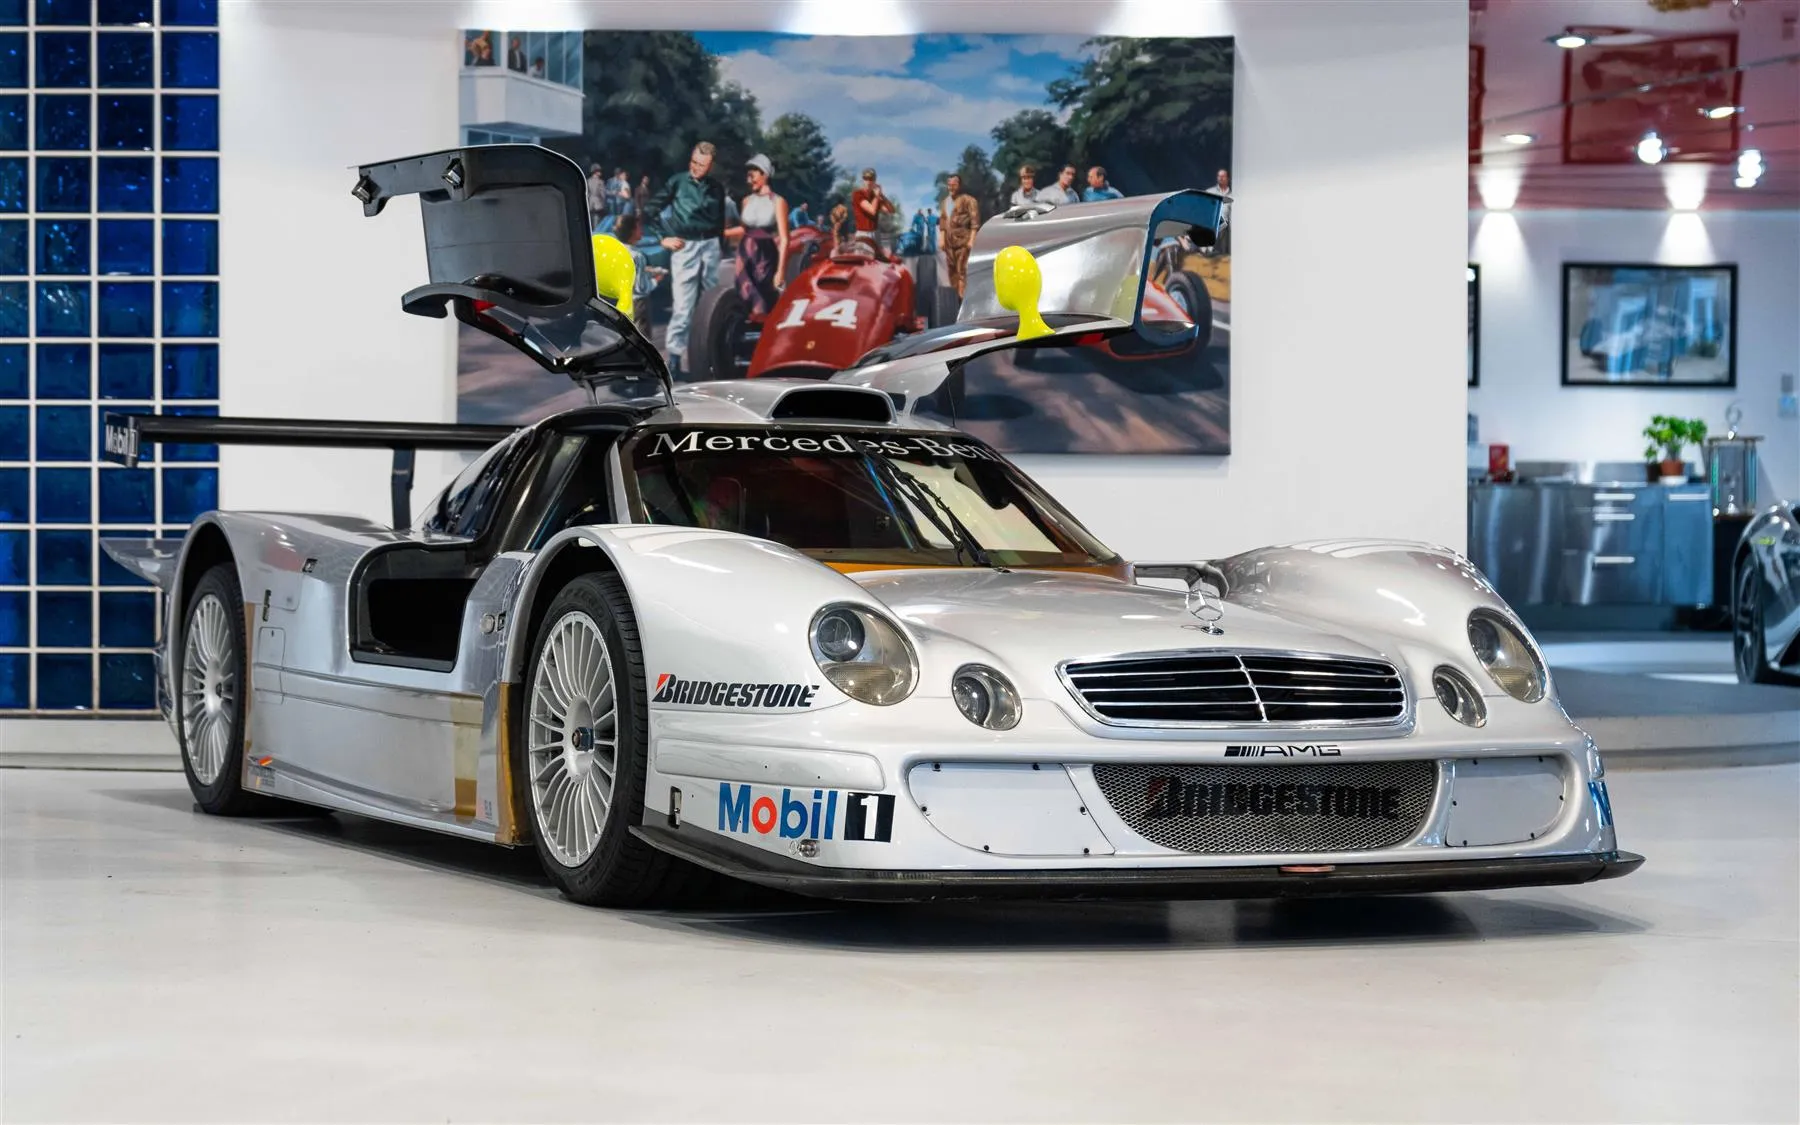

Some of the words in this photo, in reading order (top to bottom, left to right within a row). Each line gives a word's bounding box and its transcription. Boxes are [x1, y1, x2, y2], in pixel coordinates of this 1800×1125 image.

[776, 299, 858, 330] 14
[646, 431, 1004, 462] Mercedes-Ben
[652, 673, 820, 708] BRIDGESTONE
[1260, 745, 1341, 757] AMG
[717, 782, 838, 841] Mobil
[1145, 774, 1401, 819] BRIDGESTONE
